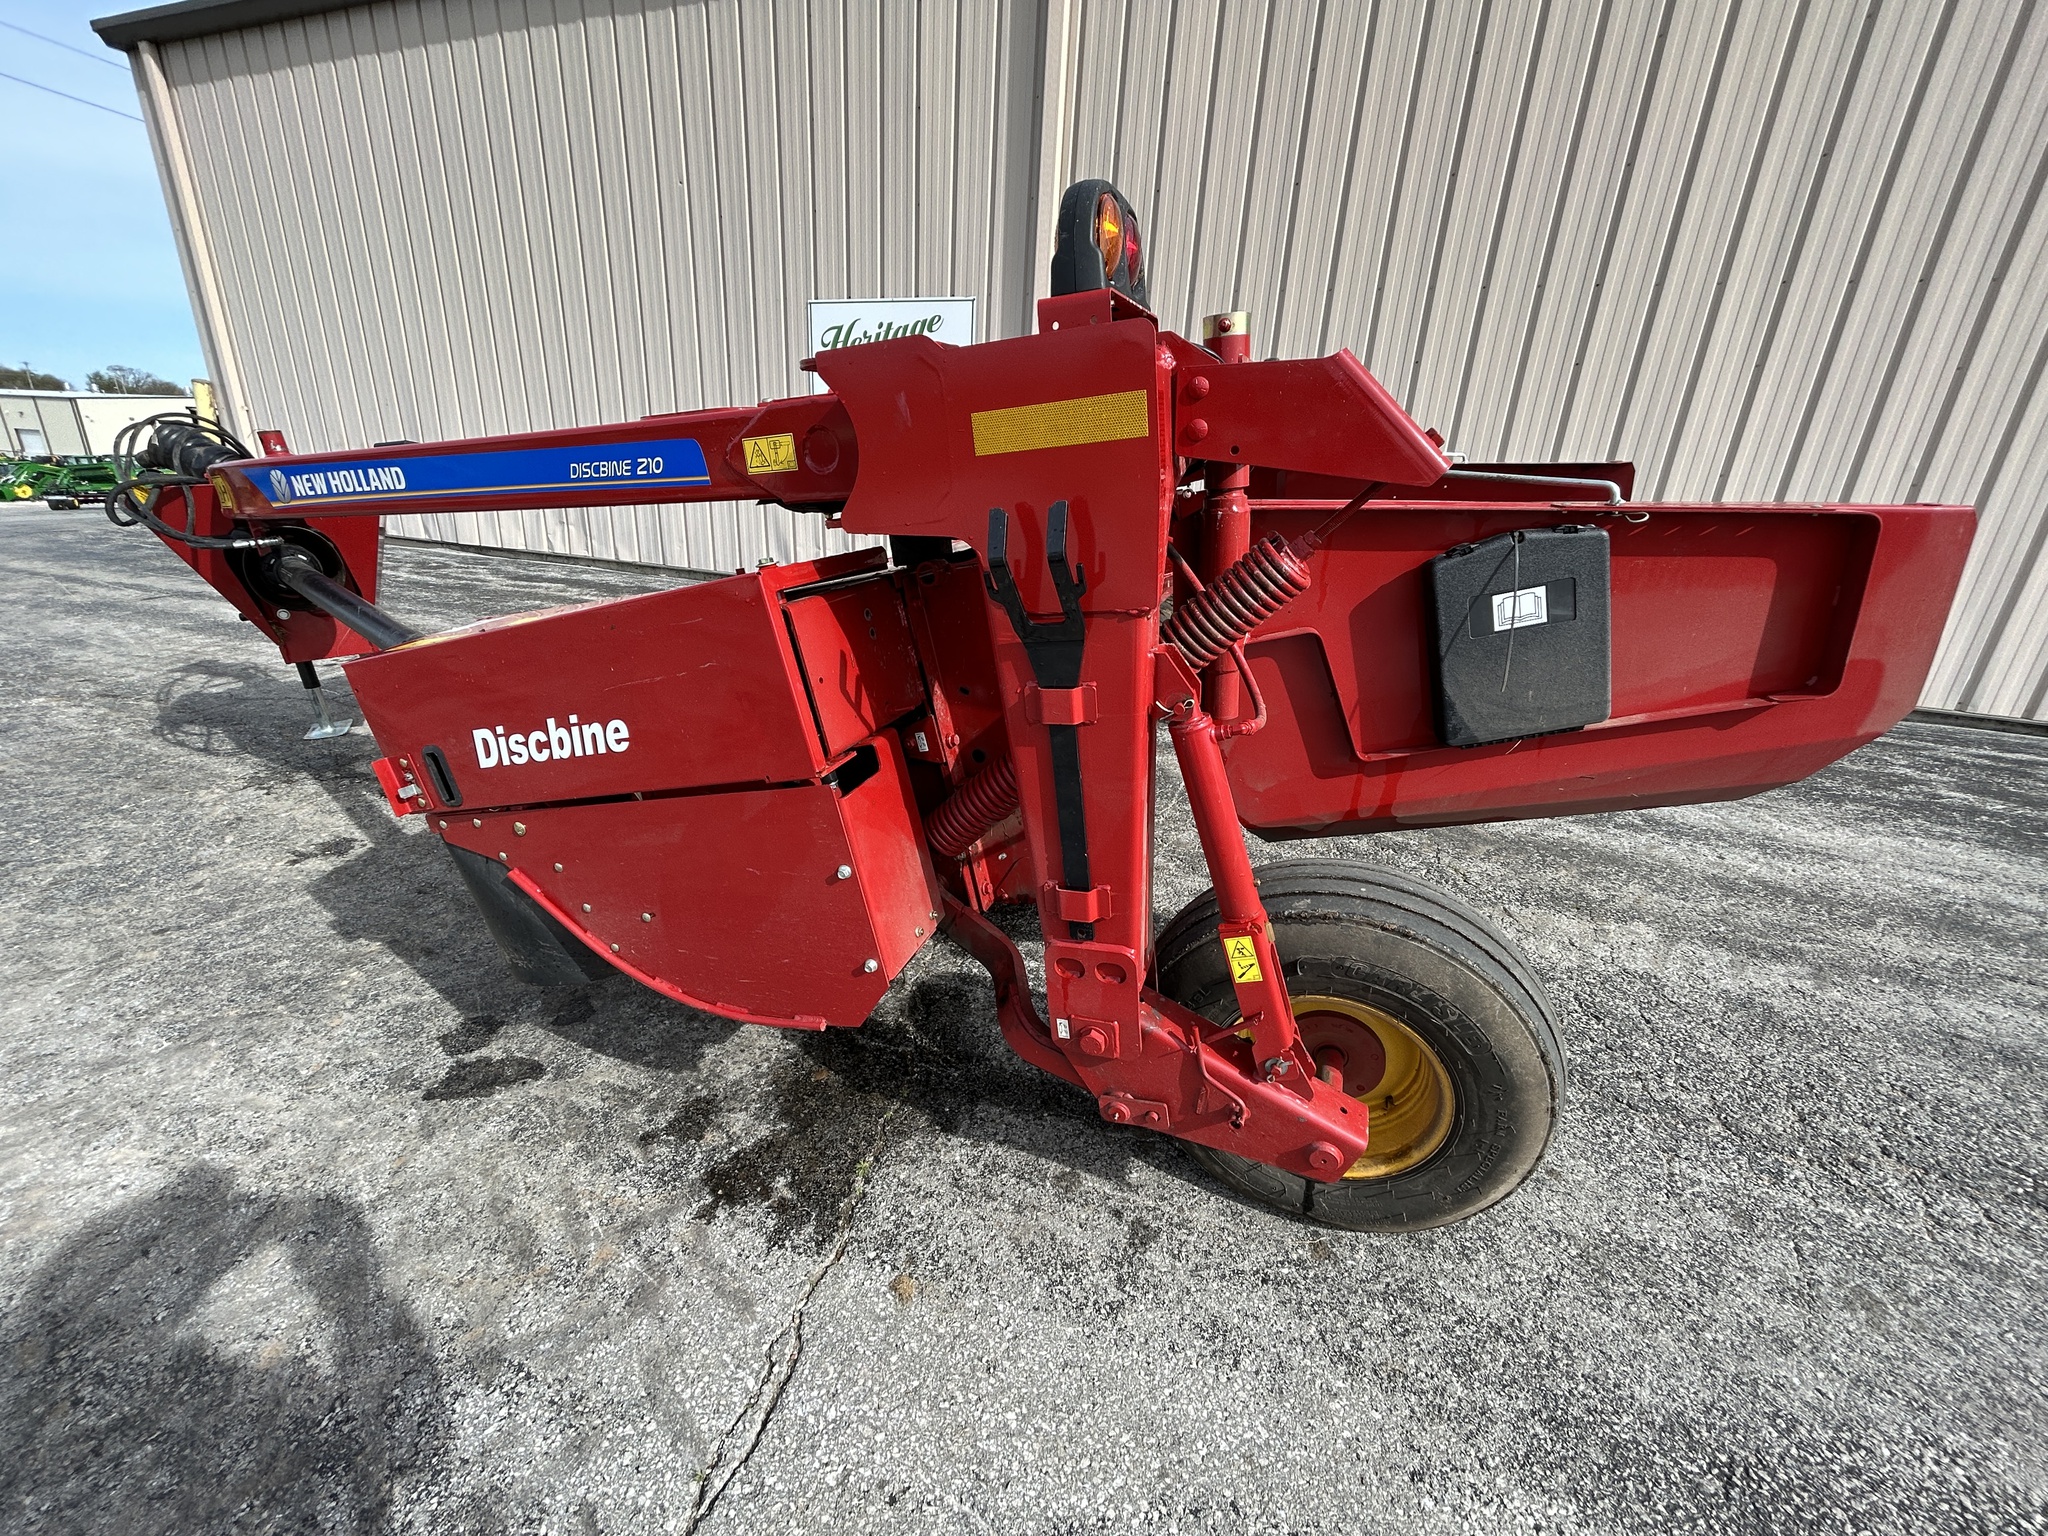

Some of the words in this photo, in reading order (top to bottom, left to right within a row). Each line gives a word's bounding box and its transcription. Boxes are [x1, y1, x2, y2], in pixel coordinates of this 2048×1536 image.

[821, 314, 944, 350] Heritage
[290, 472, 328, 497] NEW
[327, 466, 406, 494] HOLLAND
[570, 459, 632, 479] DISCBINE
[636, 456, 664, 475] 210
[471, 713, 630, 769] Discbine
[1347, 960, 1485, 1050] CARLISLE
